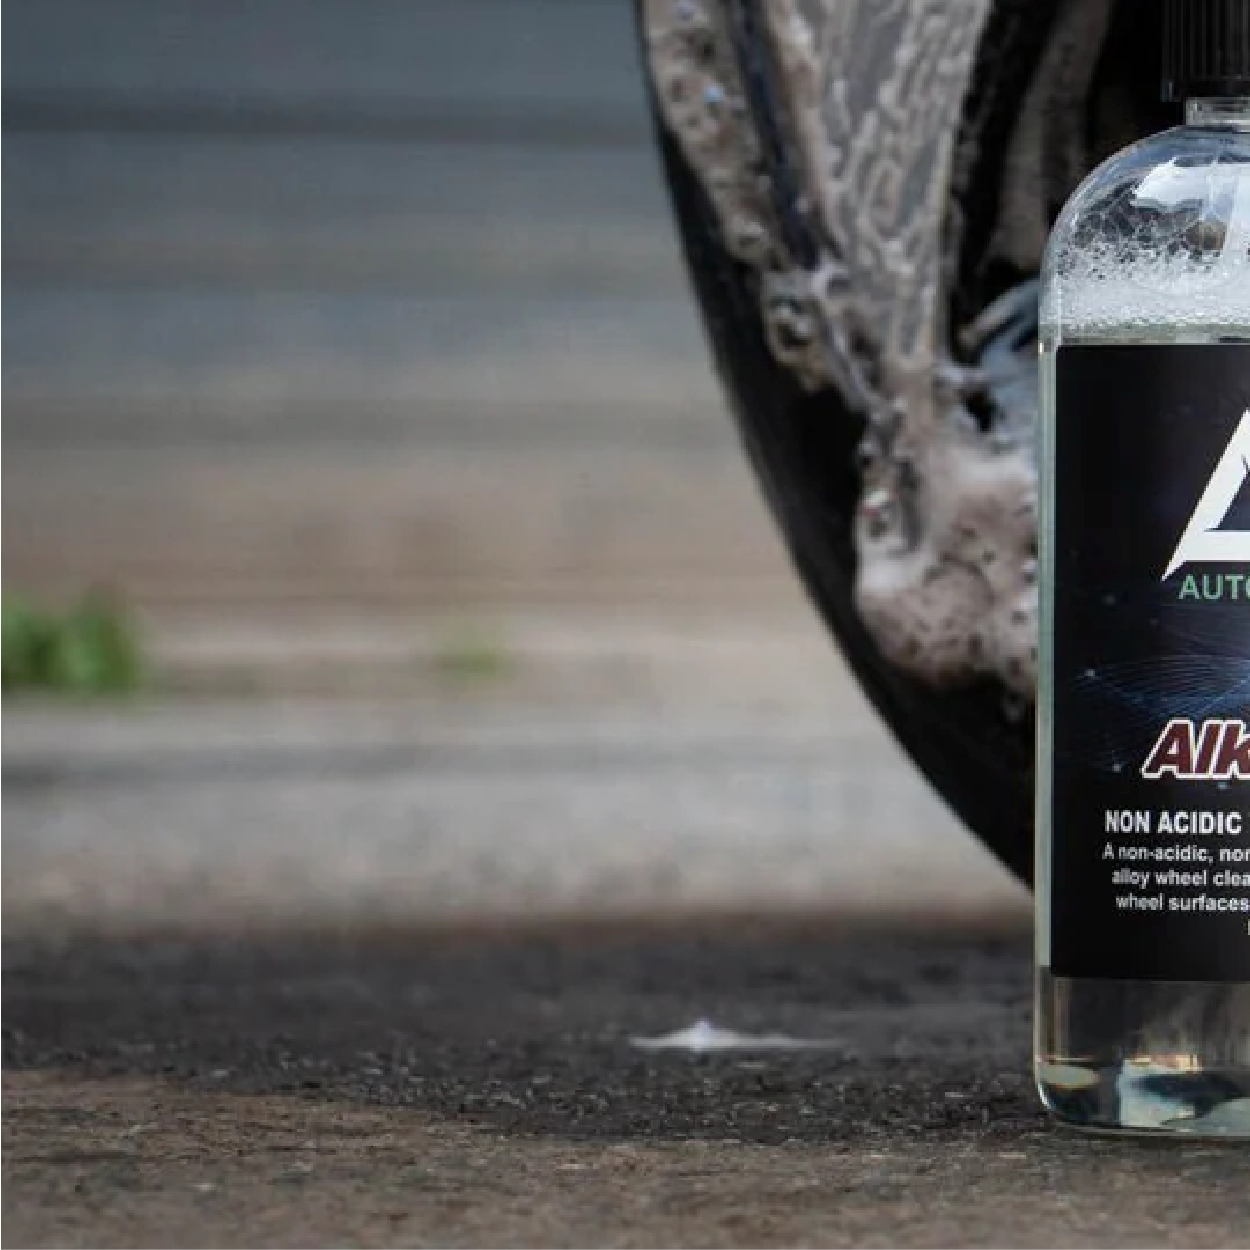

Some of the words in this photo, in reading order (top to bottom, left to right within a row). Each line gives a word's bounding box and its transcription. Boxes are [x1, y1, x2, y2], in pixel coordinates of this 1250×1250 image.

[1105, 810, 1150, 835] NON
[1157, 810, 1242, 835] ACIDIC
[1102, 843, 1114, 861] A
[1117, 842, 1214, 864] non-acidic,
[1111, 868, 1150, 889] alloy
[1155, 868, 1207, 886] wheel
[1115, 892, 1163, 911] wheel
[1168, 893, 1250, 912] surfaces
